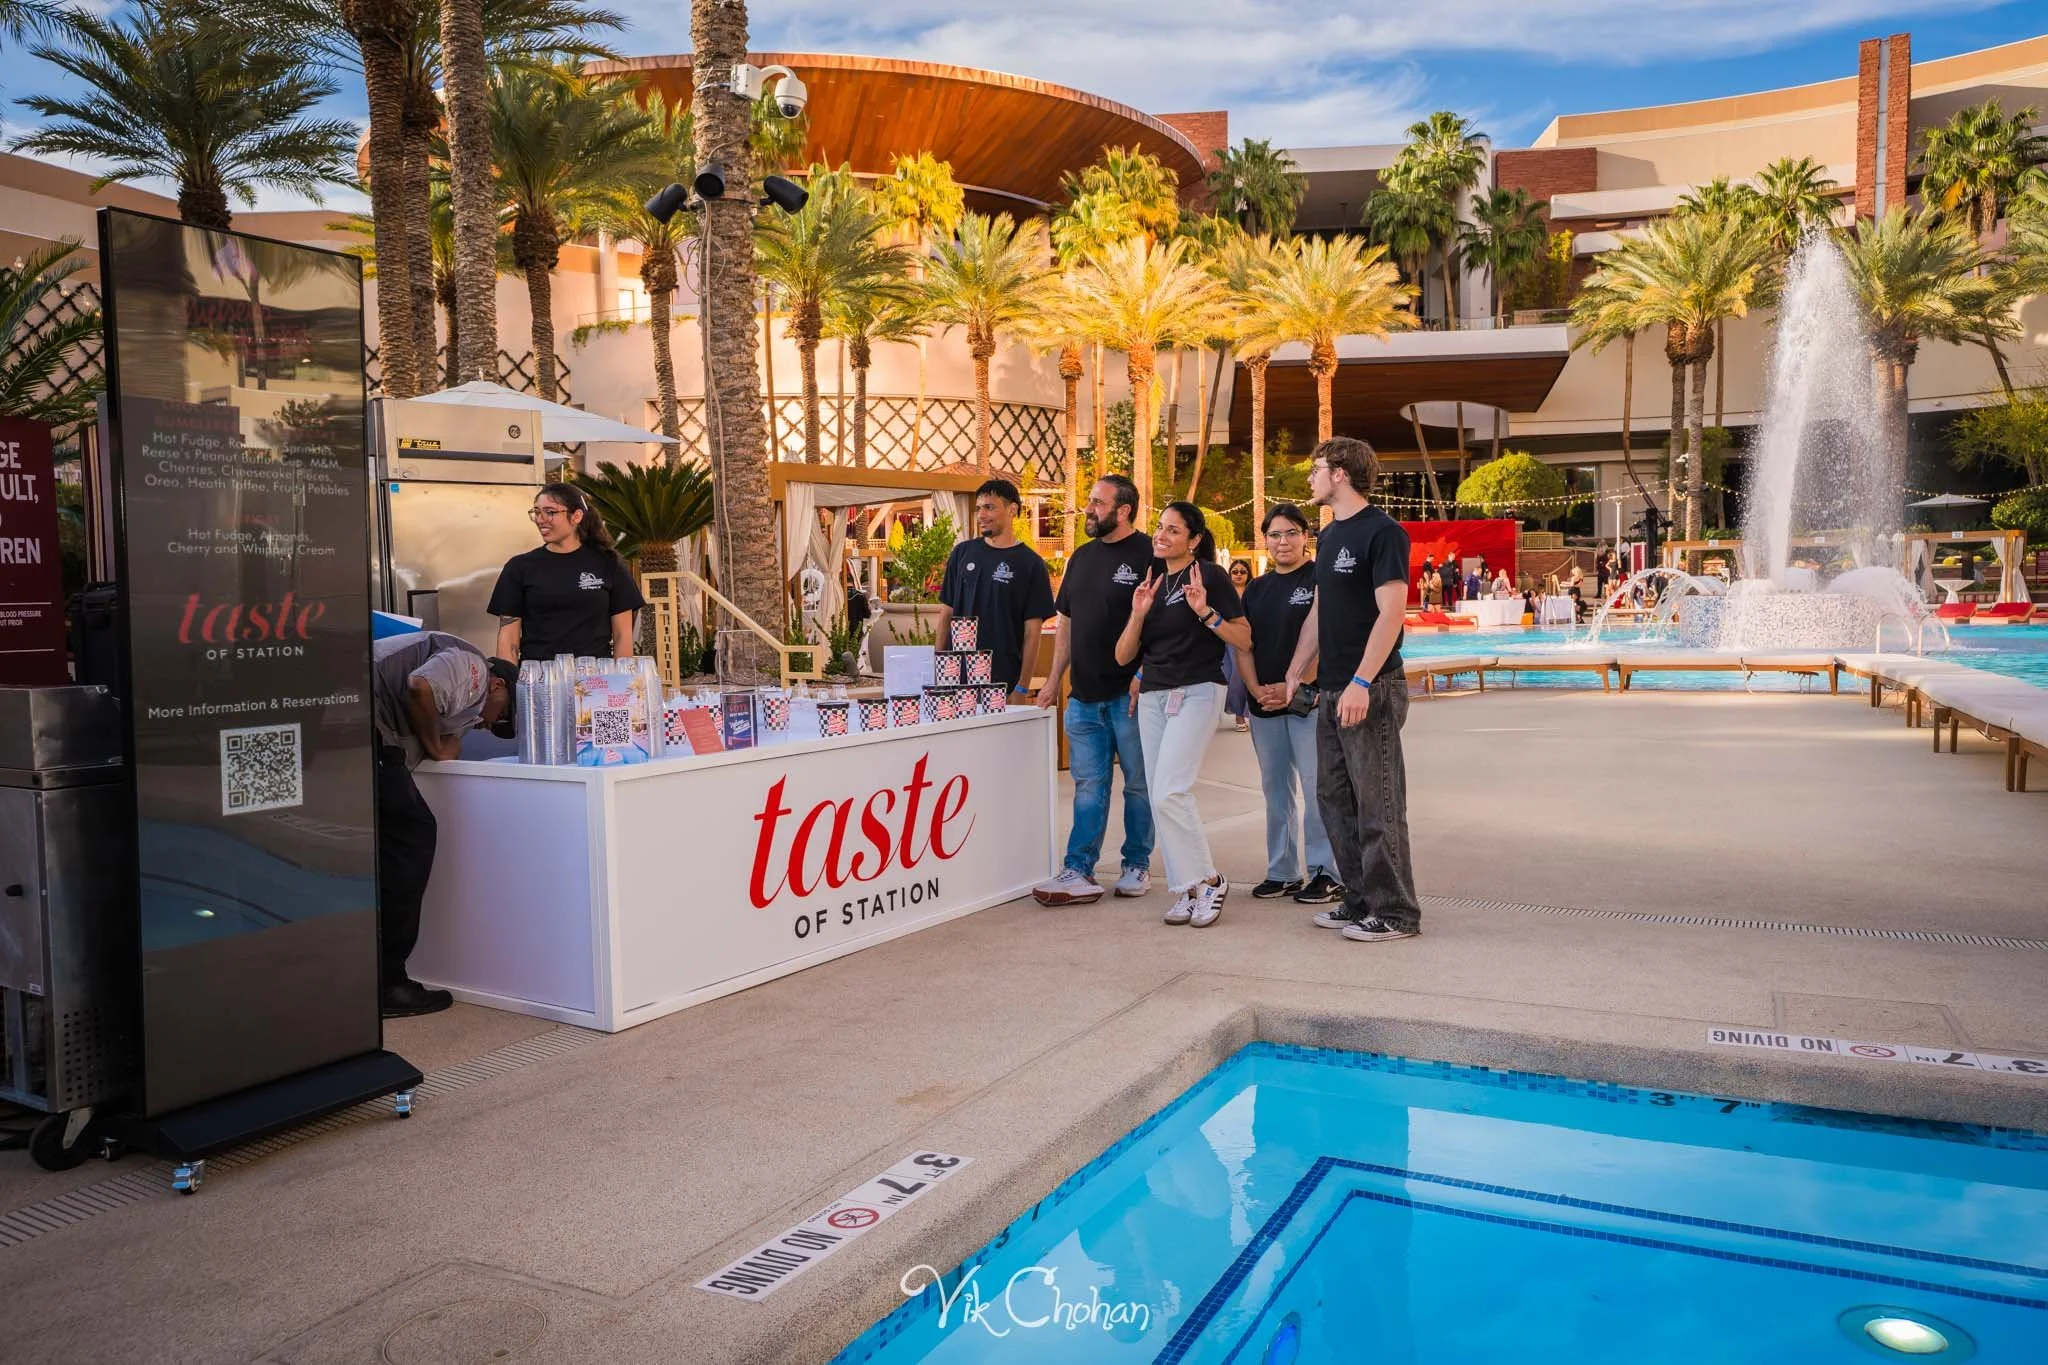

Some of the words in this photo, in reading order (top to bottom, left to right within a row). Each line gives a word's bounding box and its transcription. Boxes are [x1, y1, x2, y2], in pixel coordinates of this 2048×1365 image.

[153, 432, 176, 445] Hot
[142, 444, 191, 458] Reese's
[195, 449, 238, 463] Peanut
[221, 464, 292, 480] Cheesecake
[188, 477, 226, 489] Heath
[307, 483, 350, 497] Pebbles
[188, 528, 212, 541] Hot
[0, 537, 42, 565] REN
[167, 541, 211, 557] Cherry
[214, 543, 238, 554] and
[297, 544, 335, 556] Cream
[178, 591, 326, 644] taste
[205, 649, 228, 660] OF
[236, 645, 305, 660] STATION
[148, 707, 184, 720] More
[188, 699, 267, 717] Information
[270, 699, 279, 710] &
[282, 693, 360, 709] Reservations
[749, 752, 977, 909] taste
[794, 909, 828, 939] OF
[842, 877, 940, 926] STATION
[1712, 1030, 1790, 1048] DIVING
[1800, 1037, 1833, 1052] NO
[1915, 1055, 1937, 1063] IN
[1942, 1052, 1976, 1067] 7
[2011, 1059, 2048, 1074] 3
[1712, 1097, 1743, 1113] 7
[913, 1153, 960, 1168] 3
[923, 1168, 946, 1179] FT
[876, 1178, 928, 1195] 7
[881, 1194, 907, 1205] IN
[781, 1229, 844, 1251] NO
[708, 1248, 811, 1295] DIVING
